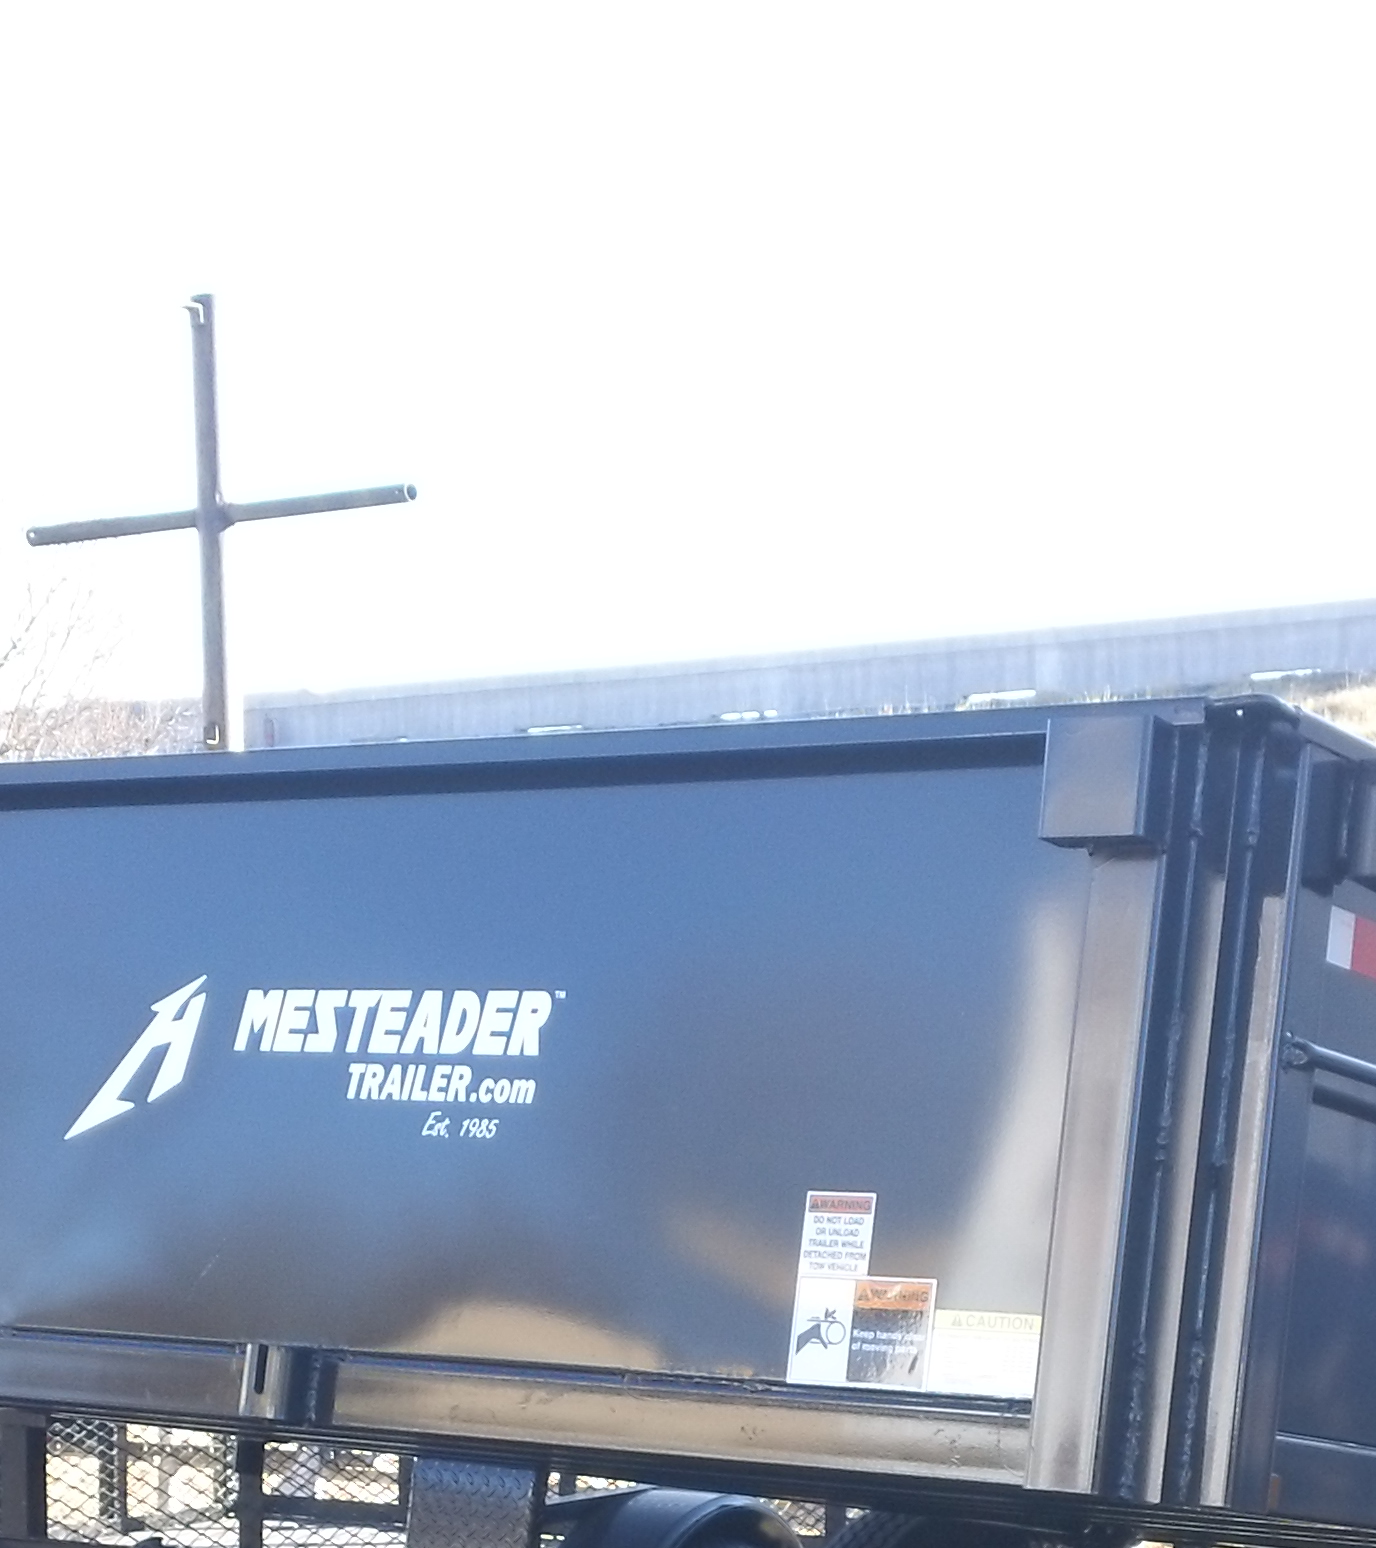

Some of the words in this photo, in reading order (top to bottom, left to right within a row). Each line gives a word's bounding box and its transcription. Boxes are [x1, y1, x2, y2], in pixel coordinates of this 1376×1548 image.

[347, 1062, 536, 1104] TRAILER.com
[421, 1111, 451, 1138] Est.
[459, 1118, 500, 1139] 1985
[821, 1200, 871, 1210] WARNING
[814, 1215, 824, 1224] DO
[827, 1216, 842, 1224] NOT
[844, 1217, 864, 1225] LOAD
[816, 1227, 826, 1235] OR
[804, 1250, 842, 1259] DETACHED
[845, 1252, 866, 1260] FROM
[966, 1314, 1034, 1330] CAUTION
